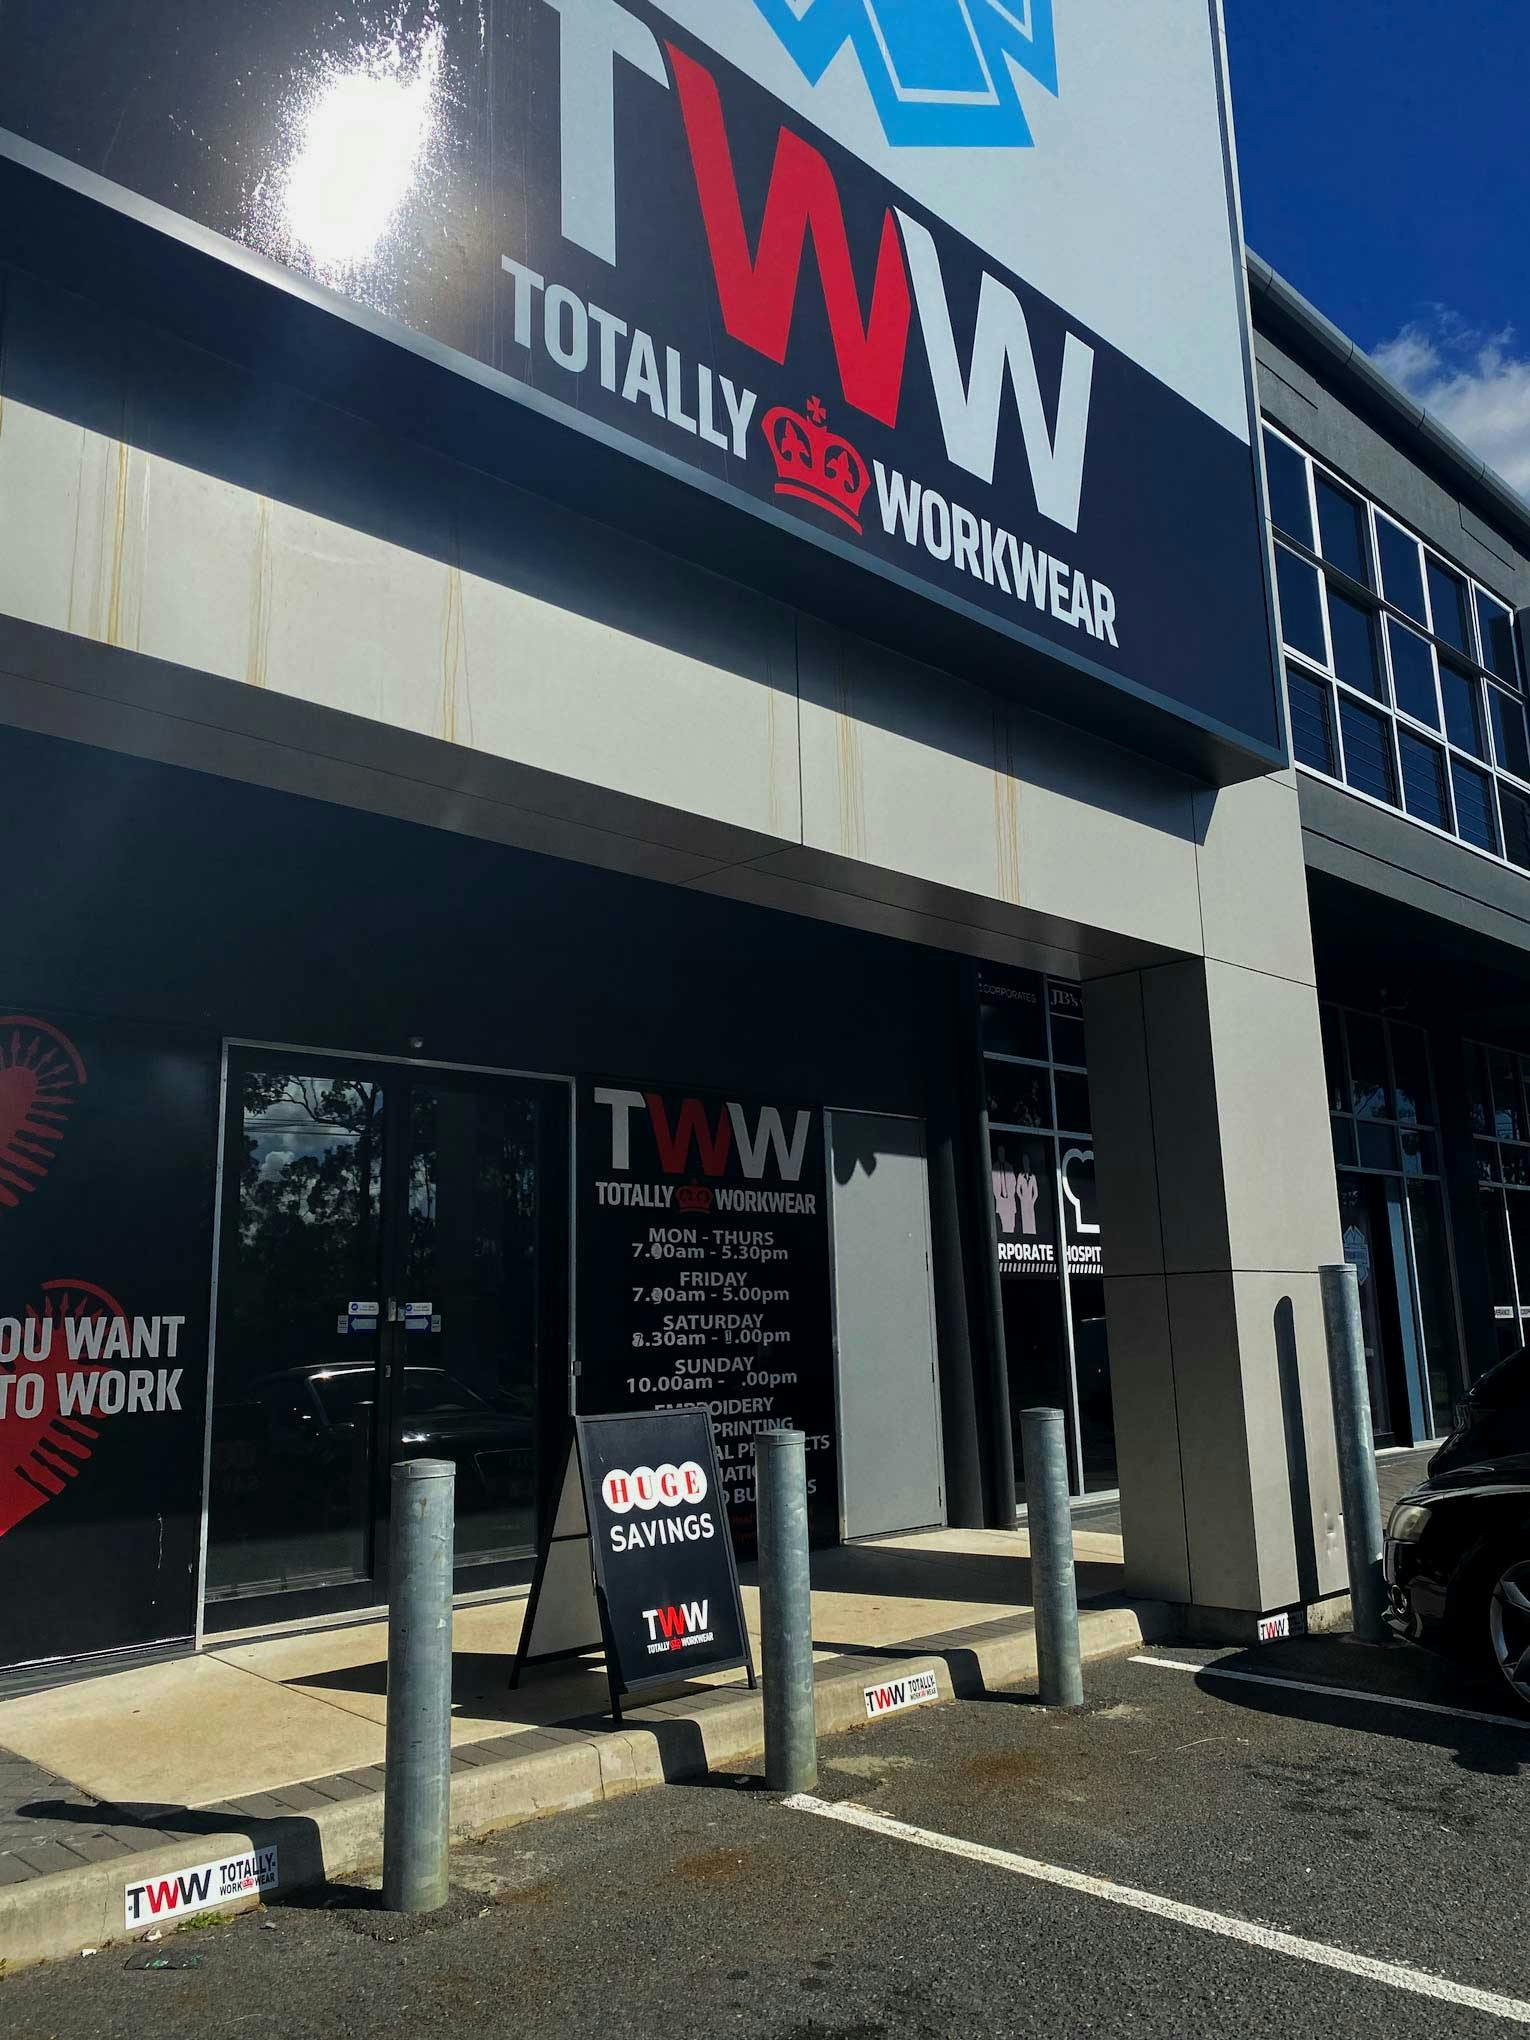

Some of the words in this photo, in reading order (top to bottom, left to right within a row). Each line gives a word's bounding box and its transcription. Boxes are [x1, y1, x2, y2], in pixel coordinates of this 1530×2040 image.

[542, 0, 1094, 533] TWW
[502, 254, 757, 459] TOTALLY
[873, 460, 1118, 647] WORKWEAR
[594, 1087, 811, 1181] TWW
[595, 1181, 674, 1208] TOTALLY
[715, 1188, 816, 1214] WORKWEAR
[649, 1228, 697, 1244] MON
[712, 1230, 774, 1246] THURS
[722, 1246, 788, 1263] 5.30pm
[997, 1242, 1054, 1261] RPORATE
[1065, 1245, 1102, 1263] HOSPIT
[680, 1271, 748, 1287] FRIDAY
[722, 1287, 789, 1304] 5.00pm
[663, 1314, 764, 1330] SATURDAY
[0, 1317, 52, 1363] OU
[65, 1316, 185, 1360] WANT
[675, 1357, 754, 1374] SUNDAY
[0, 1373, 45, 1419] TO
[56, 1369, 183, 1416] WORK
[627, 1377, 713, 1393] 10.00am
[655, 1397, 774, 1415] OIDERY
[609, 1470, 700, 1504] HUGE
[610, 1512, 715, 1552] SAVINGS
[642, 1600, 708, 1640] TWW
[647, 1641, 670, 1654] TOTALLY
[681, 1632, 714, 1647] WORKWEAR
[908, 1675, 935, 1693] TOTALLY
[866, 1683, 904, 1711] TWW
[219, 1852, 274, 1884] TOTALLY
[127, 1869, 211, 1919] TWW
[219, 1881, 243, 1896] WORK
[255, 1872, 275, 1887] WEAR
